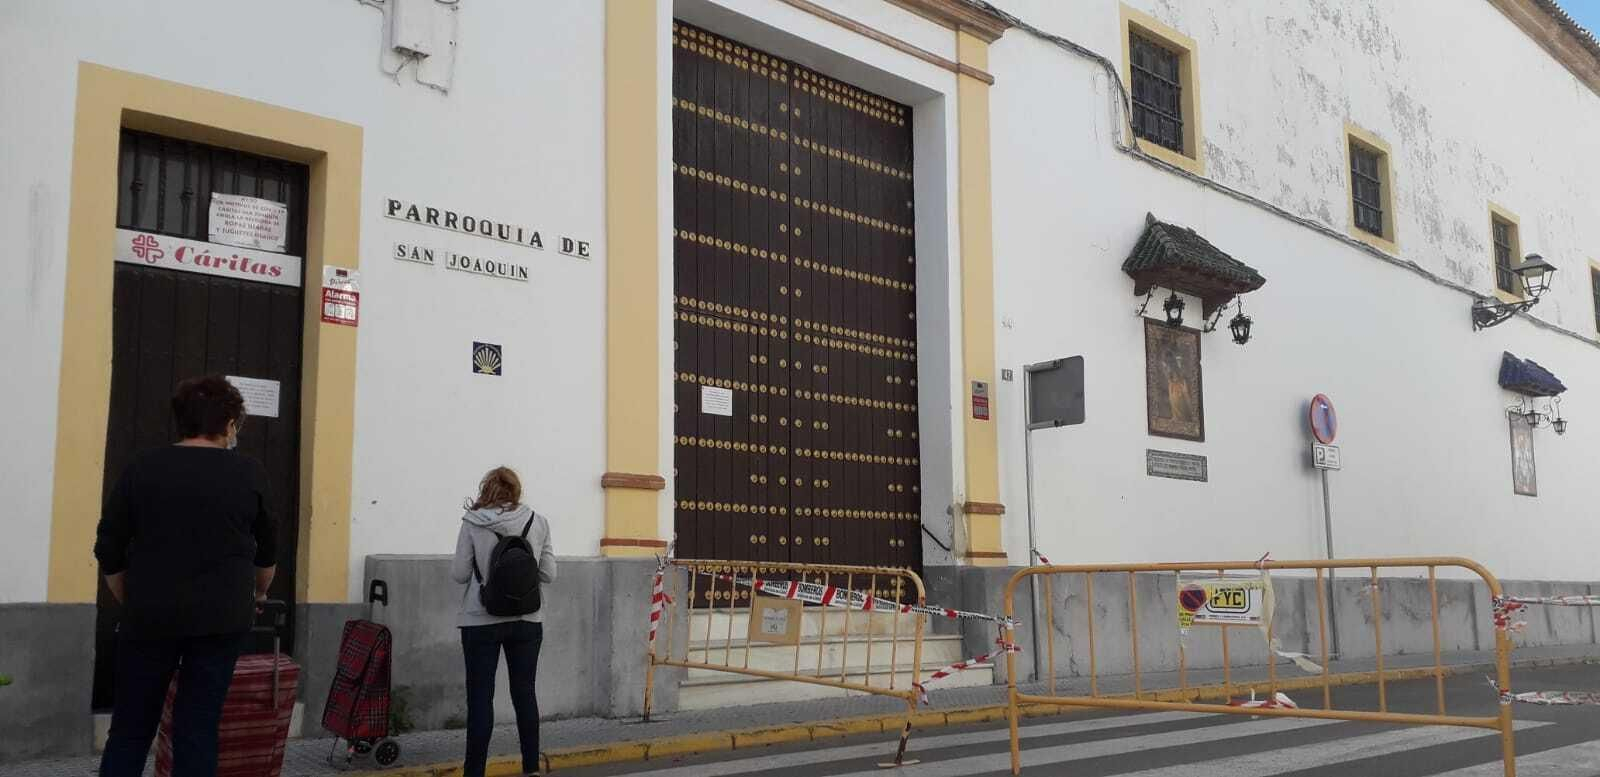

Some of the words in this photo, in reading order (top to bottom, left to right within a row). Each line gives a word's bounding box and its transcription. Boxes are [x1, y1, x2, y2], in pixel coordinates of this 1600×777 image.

[387, 198, 543, 249] PARROQUIA
[562, 236, 590, 257] DE
[174, 246, 282, 277] Cáritas
[397, 244, 433, 262] SAN
[450, 254, 528, 279] JOAQUIN
[325, 288, 357, 302] Alarma
